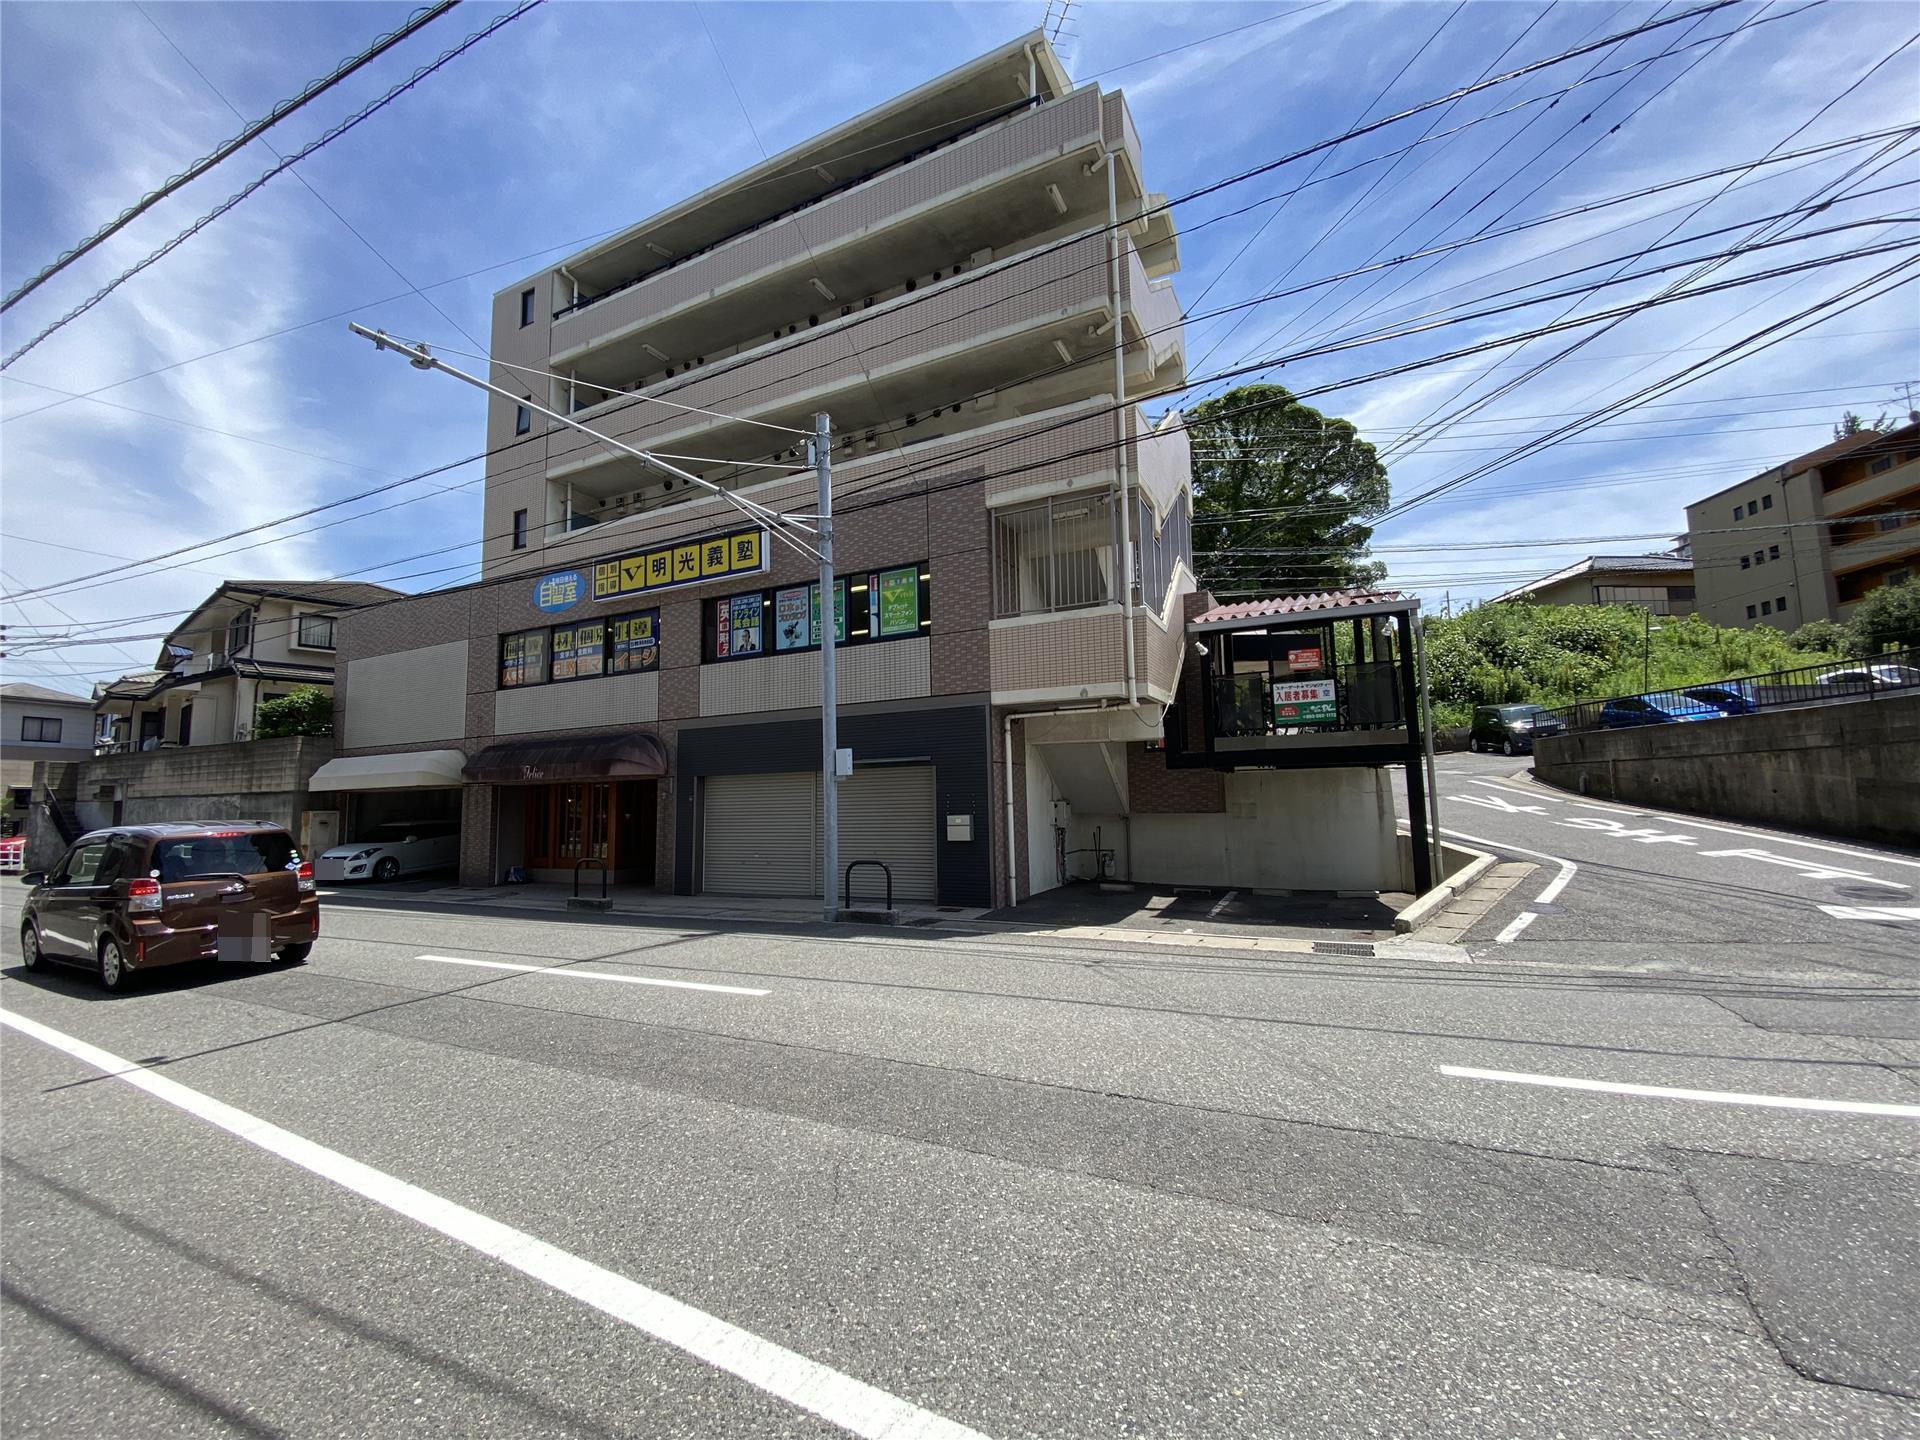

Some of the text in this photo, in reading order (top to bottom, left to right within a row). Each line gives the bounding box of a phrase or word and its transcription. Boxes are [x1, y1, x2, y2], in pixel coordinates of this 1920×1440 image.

[652, 539, 754, 577] 明光義塾
[540, 581, 577, 607] 自習室
[1276, 689, 1319, 702] 入居者募集
